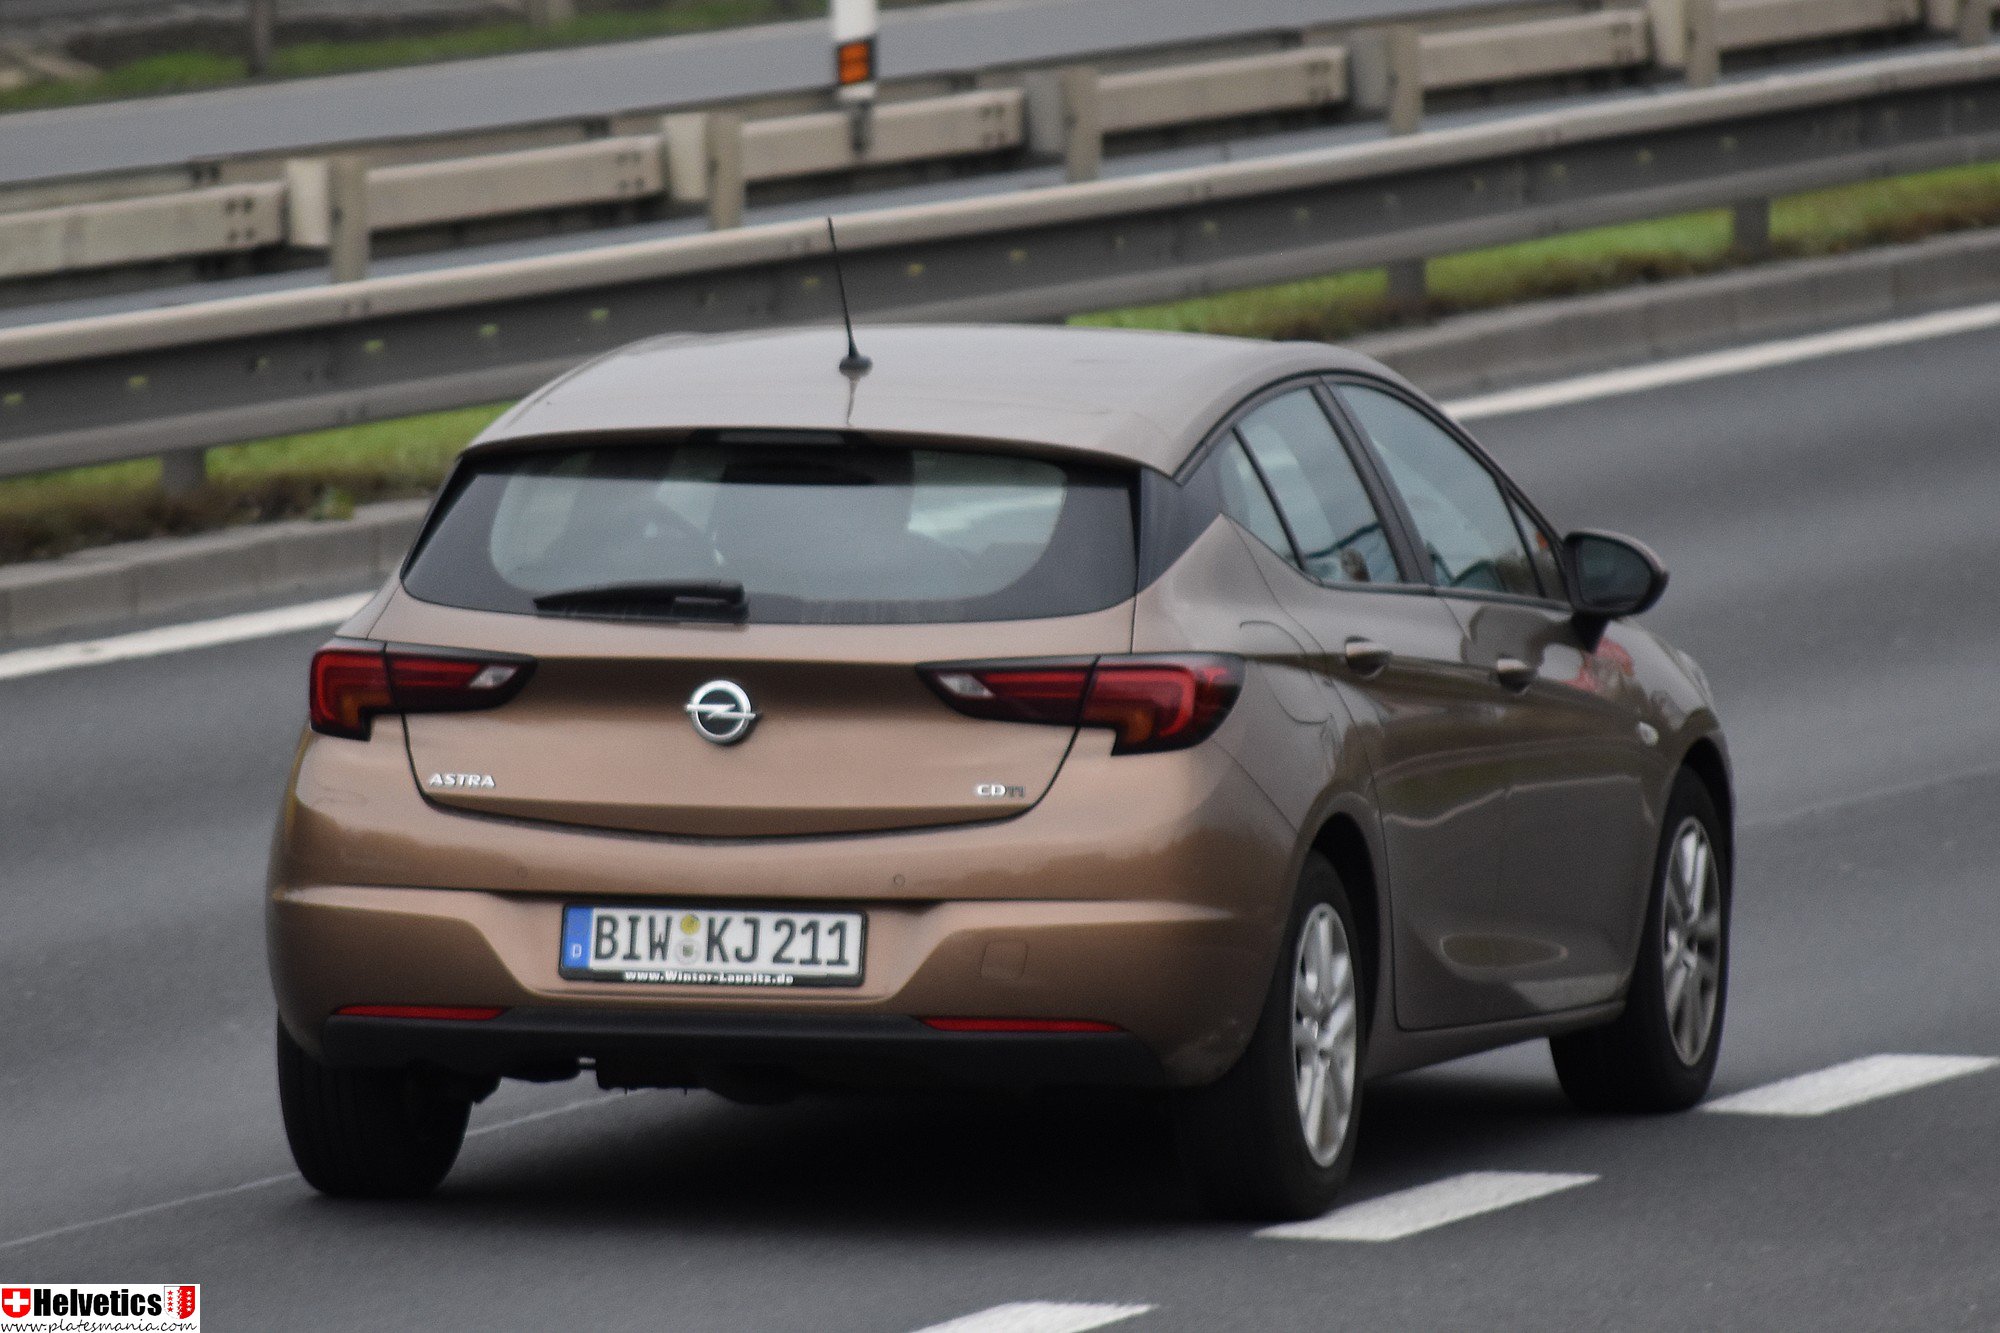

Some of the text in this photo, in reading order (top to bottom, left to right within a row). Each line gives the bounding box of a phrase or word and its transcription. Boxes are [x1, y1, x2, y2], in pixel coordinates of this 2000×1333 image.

[429, 773, 497, 788] ASTRA
[594, 914, 850, 966] BIW KJ 211
